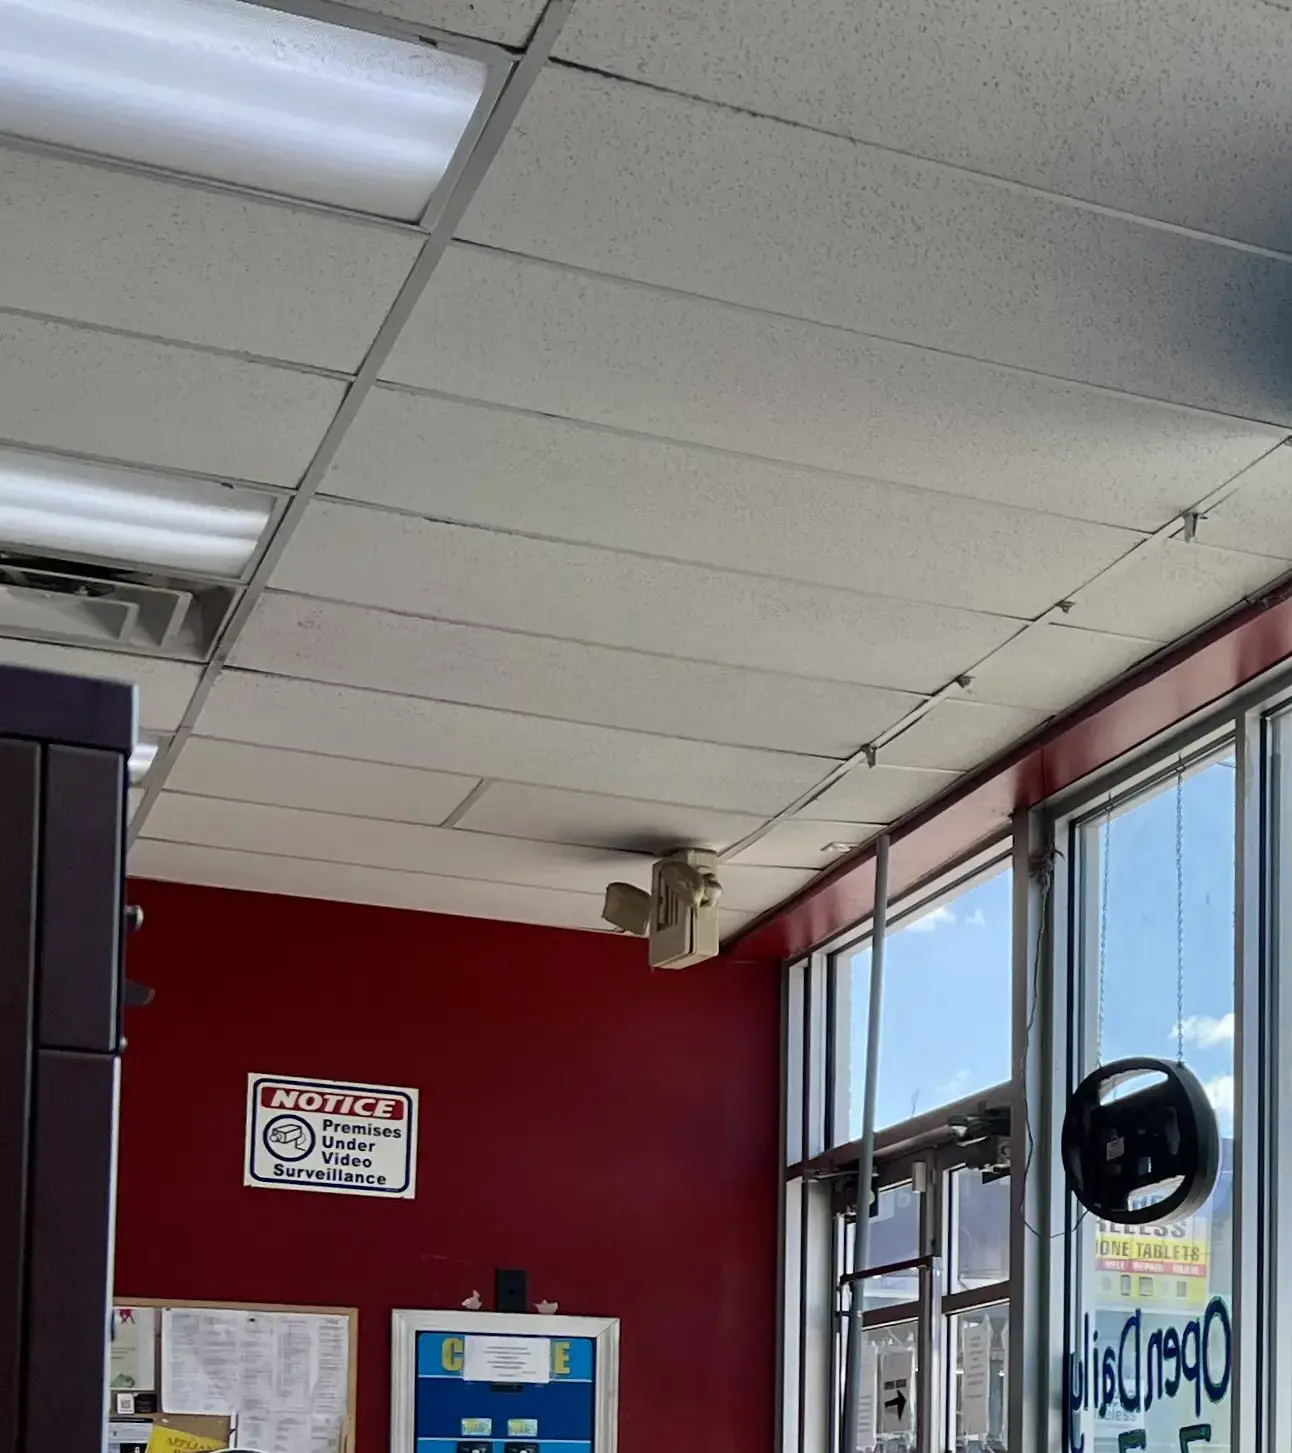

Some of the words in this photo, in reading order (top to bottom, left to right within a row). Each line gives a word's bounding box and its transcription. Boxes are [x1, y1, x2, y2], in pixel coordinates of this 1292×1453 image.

[270, 1088, 396, 1118] NOTICE
[322, 1119, 402, 1139] Premises
[322, 1135, 376, 1152] Under
[321, 1151, 372, 1168] Video
[273, 1163, 387, 1185] Surveillance
[1096, 1239, 1130, 1256] ONE
[1136, 1242, 1200, 1261] TABLETS
